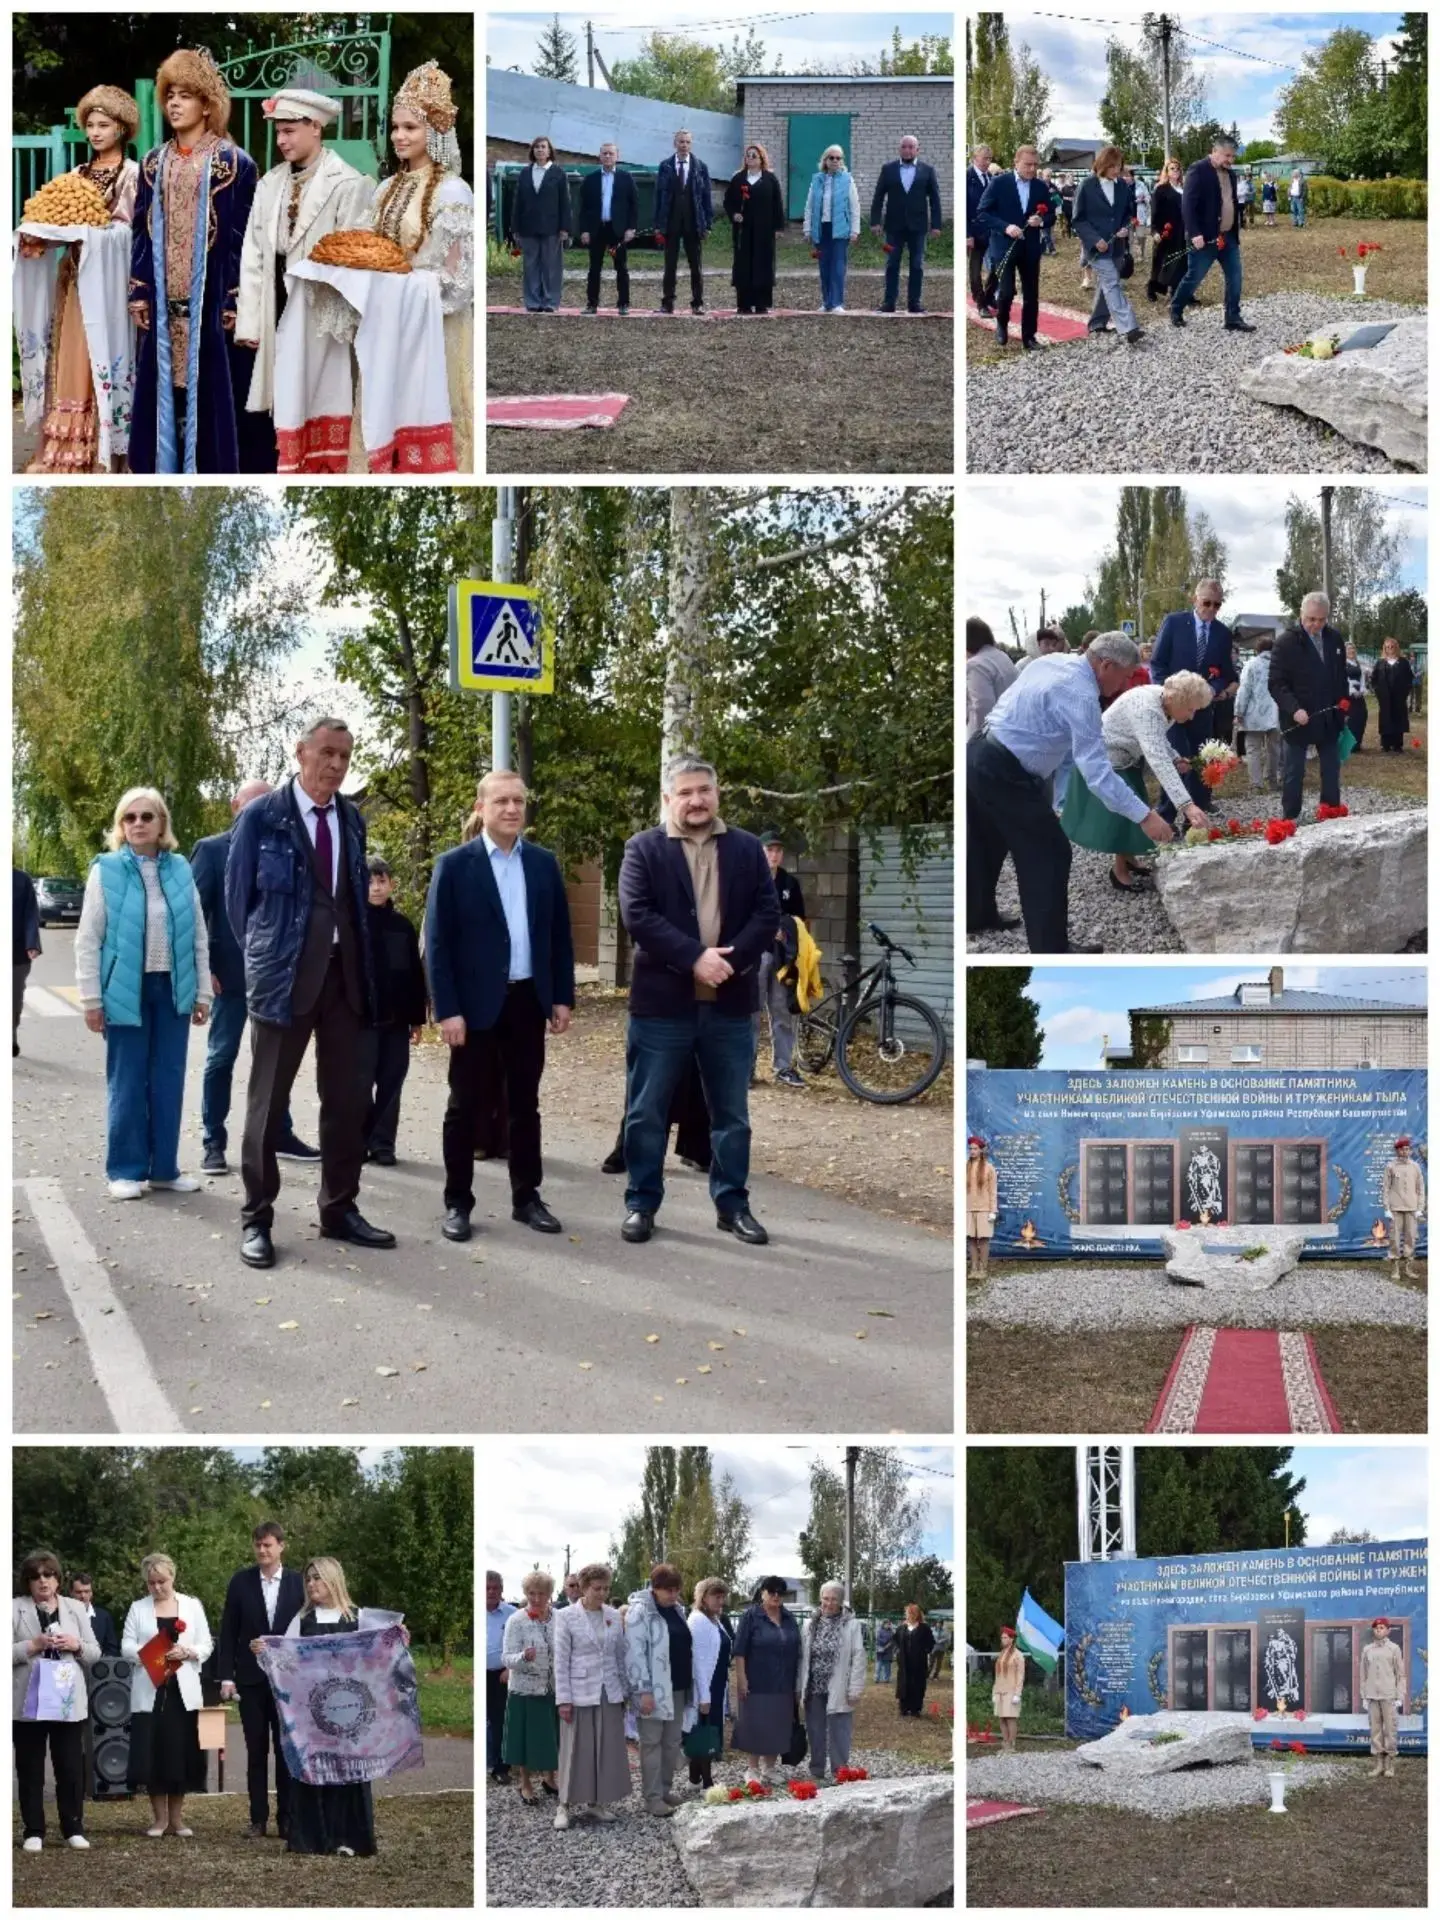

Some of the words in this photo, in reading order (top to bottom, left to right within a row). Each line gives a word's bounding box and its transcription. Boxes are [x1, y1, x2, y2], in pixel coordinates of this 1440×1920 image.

[1067, 1078, 1102, 1091] ЗДЕСЬ
[1105, 1078, 1160, 1088] ЗАЛОЖЕН
[1162, 1078, 1208, 1088] КАМЕНЬ
[1210, 1078, 1218, 1088] В
[1220, 1078, 1287, 1088] ОСНОВАНИЕ
[1288, 1078, 1357, 1088] ПАМЯТНИКА
[1016, 1093, 1093, 1105] УЧАСТНИКАМ
[1095, 1091, 1146, 1104] ВЕЛИКОЙ
[1149, 1091, 1240, 1104] ОТЕЧЕСТВЕННОЙ
[1242, 1091, 1283, 1104] ВОЙНЫ
[1285, 1093, 1293, 1103] И
[1296, 1092, 1373, 1103] ТРУЖЕНИКАМ
[1375, 1091, 1407, 1102] ТЫЛА
[1156, 1563, 1187, 1578] ЗДЕСЬ
[1190, 1561, 1241, 1575] ЗАЛОЖЕН
[1241, 1559, 1285, 1572] КАМЕНЬ
[1287, 1557, 1295, 1569] В
[1297, 1552, 1366, 1568] ОСНОВАНИЕ
[1115, 1581, 1178, 1593] УЧАСТНИКАМ
[1181, 1576, 1225, 1590] ВЕЛИКОЙ
[1228, 1570, 1317, 1588] ОТЕЧЕСТВЕННОЙ
[1319, 1566, 1361, 1583] ВОЙНЫ
[1364, 1569, 1373, 1580] И
[1375, 1565, 1427, 1580] ТРУЖЕН
[1365, 1584, 1426, 1597] Республики
